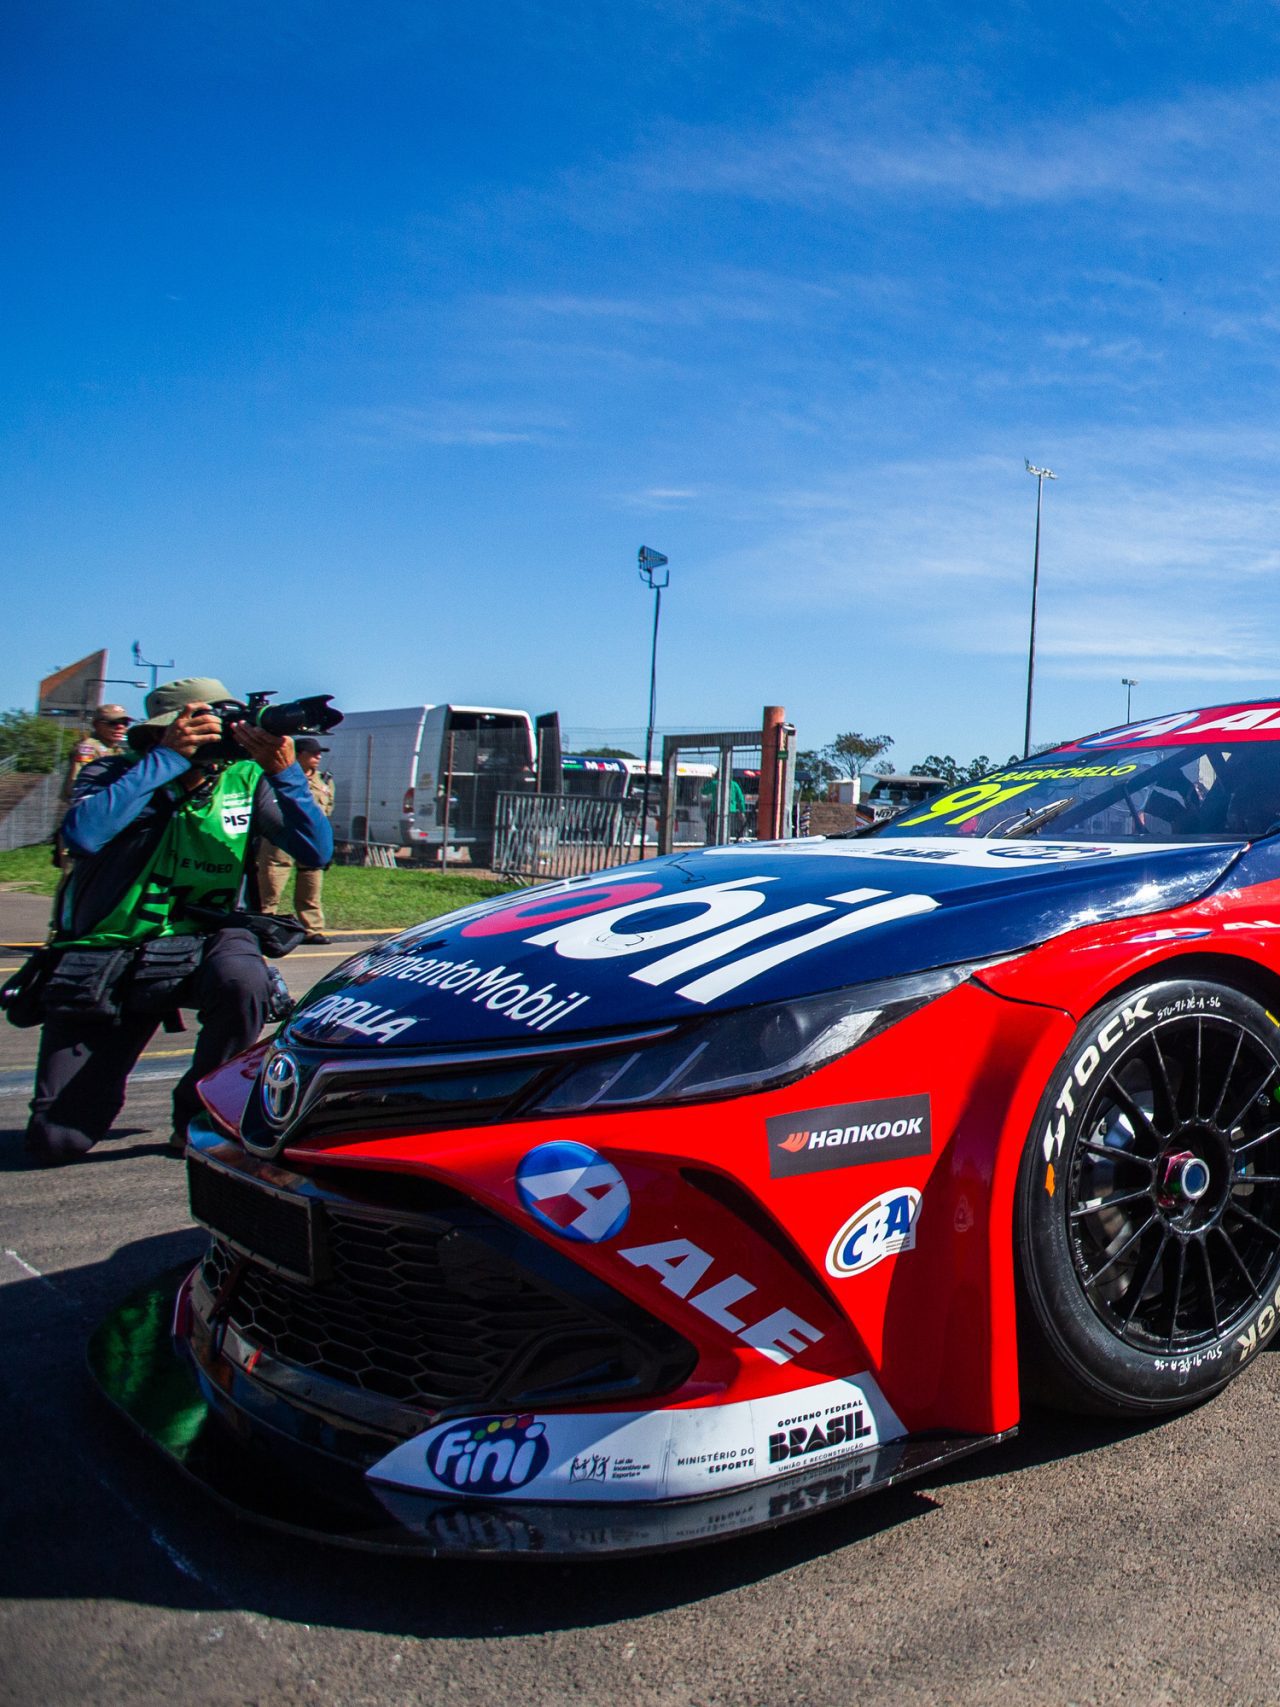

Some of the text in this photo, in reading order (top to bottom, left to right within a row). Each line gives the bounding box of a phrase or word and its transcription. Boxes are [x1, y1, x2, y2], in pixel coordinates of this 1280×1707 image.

[1003, 764, 1138, 783] BARRICHELLO
[897, 782, 1040, 827] 91
[1043, 997, 1154, 1162] STOCK
[842, 1194, 911, 1266] CBA
[616, 1238, 826, 1366] ALE
[768, 1410, 872, 1464] BRASIL
[777, 1400, 863, 1428] GOVERNO FEDERAL
[435, 1423, 546, 1485] Fini
[677, 1447, 755, 1467] MINISTÉRIO DO
[708, 1459, 755, 1474] ESPORTE
